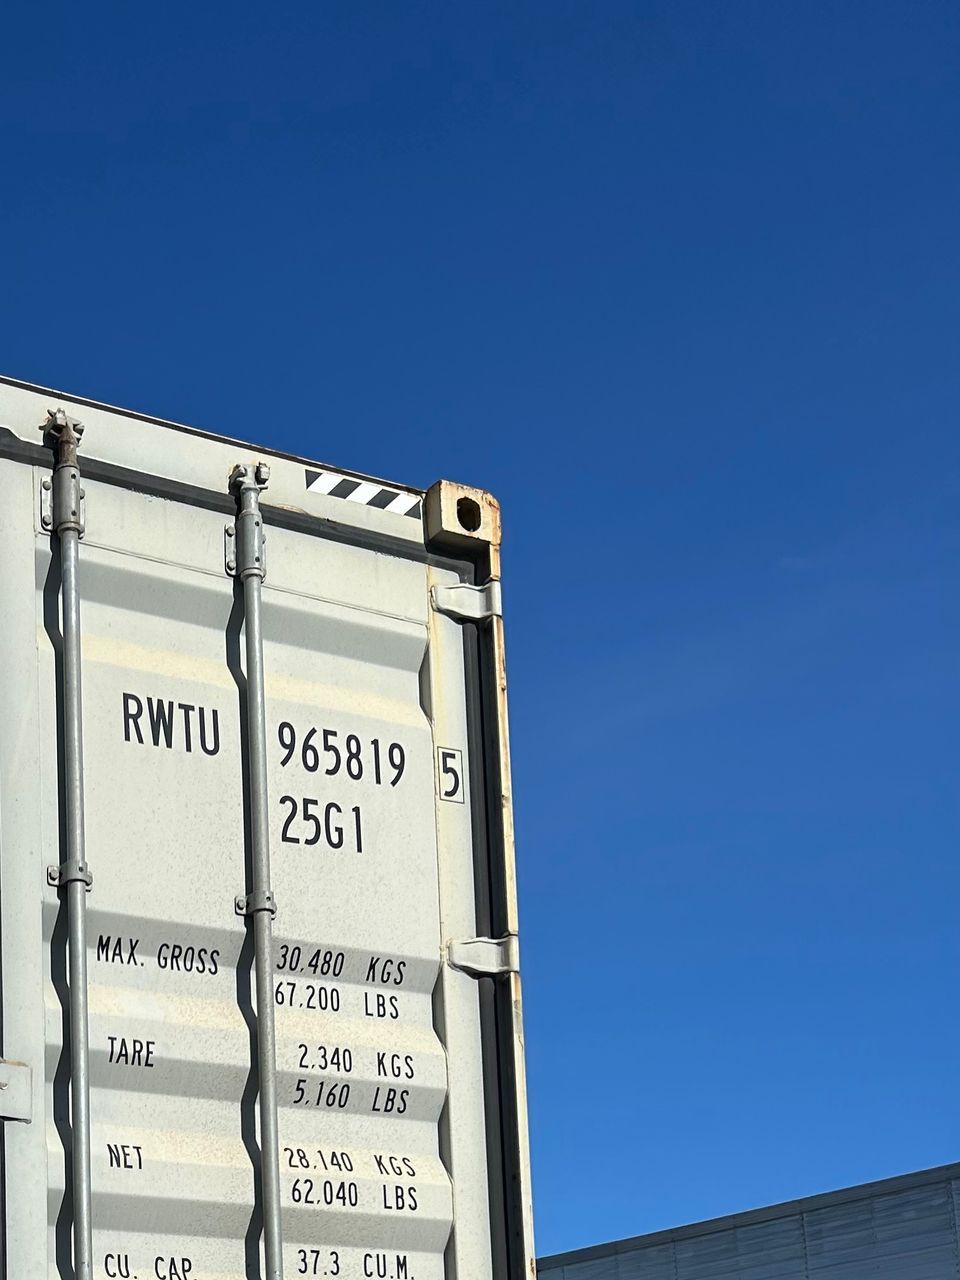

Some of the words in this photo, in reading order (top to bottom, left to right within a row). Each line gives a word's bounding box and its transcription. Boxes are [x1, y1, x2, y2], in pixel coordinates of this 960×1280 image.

[122, 692, 221, 757] RWTU
[277, 721, 407, 788] 965819
[441, 751, 461, 798] 5
[279, 795, 363, 854] 25G1
[96, 934, 145, 967] MAX.
[157, 943, 220, 976] GROSS
[276, 944, 345, 978] 30,480
[365, 956, 407, 986] KGS
[274, 981, 341, 1013] 67,200
[364, 991, 400, 1020] LBS
[107, 1036, 156, 1068] TARE
[298, 1043, 353, 1073] 2,340
[377, 1051, 415, 1079] KGS
[293, 1079, 351, 1109] 5,160
[371, 1086, 410, 1114] LBS
[106, 1143, 143, 1170] NET
[373, 1154, 417, 1178] KGS
[291, 1178, 359, 1208] 62,040
[382, 1184, 418, 1212] LBS
[104, 1253, 138, 1279] CU.
[297, 1249, 340, 1276] 37.3
[363, 1253, 416, 1280] CU.M.
